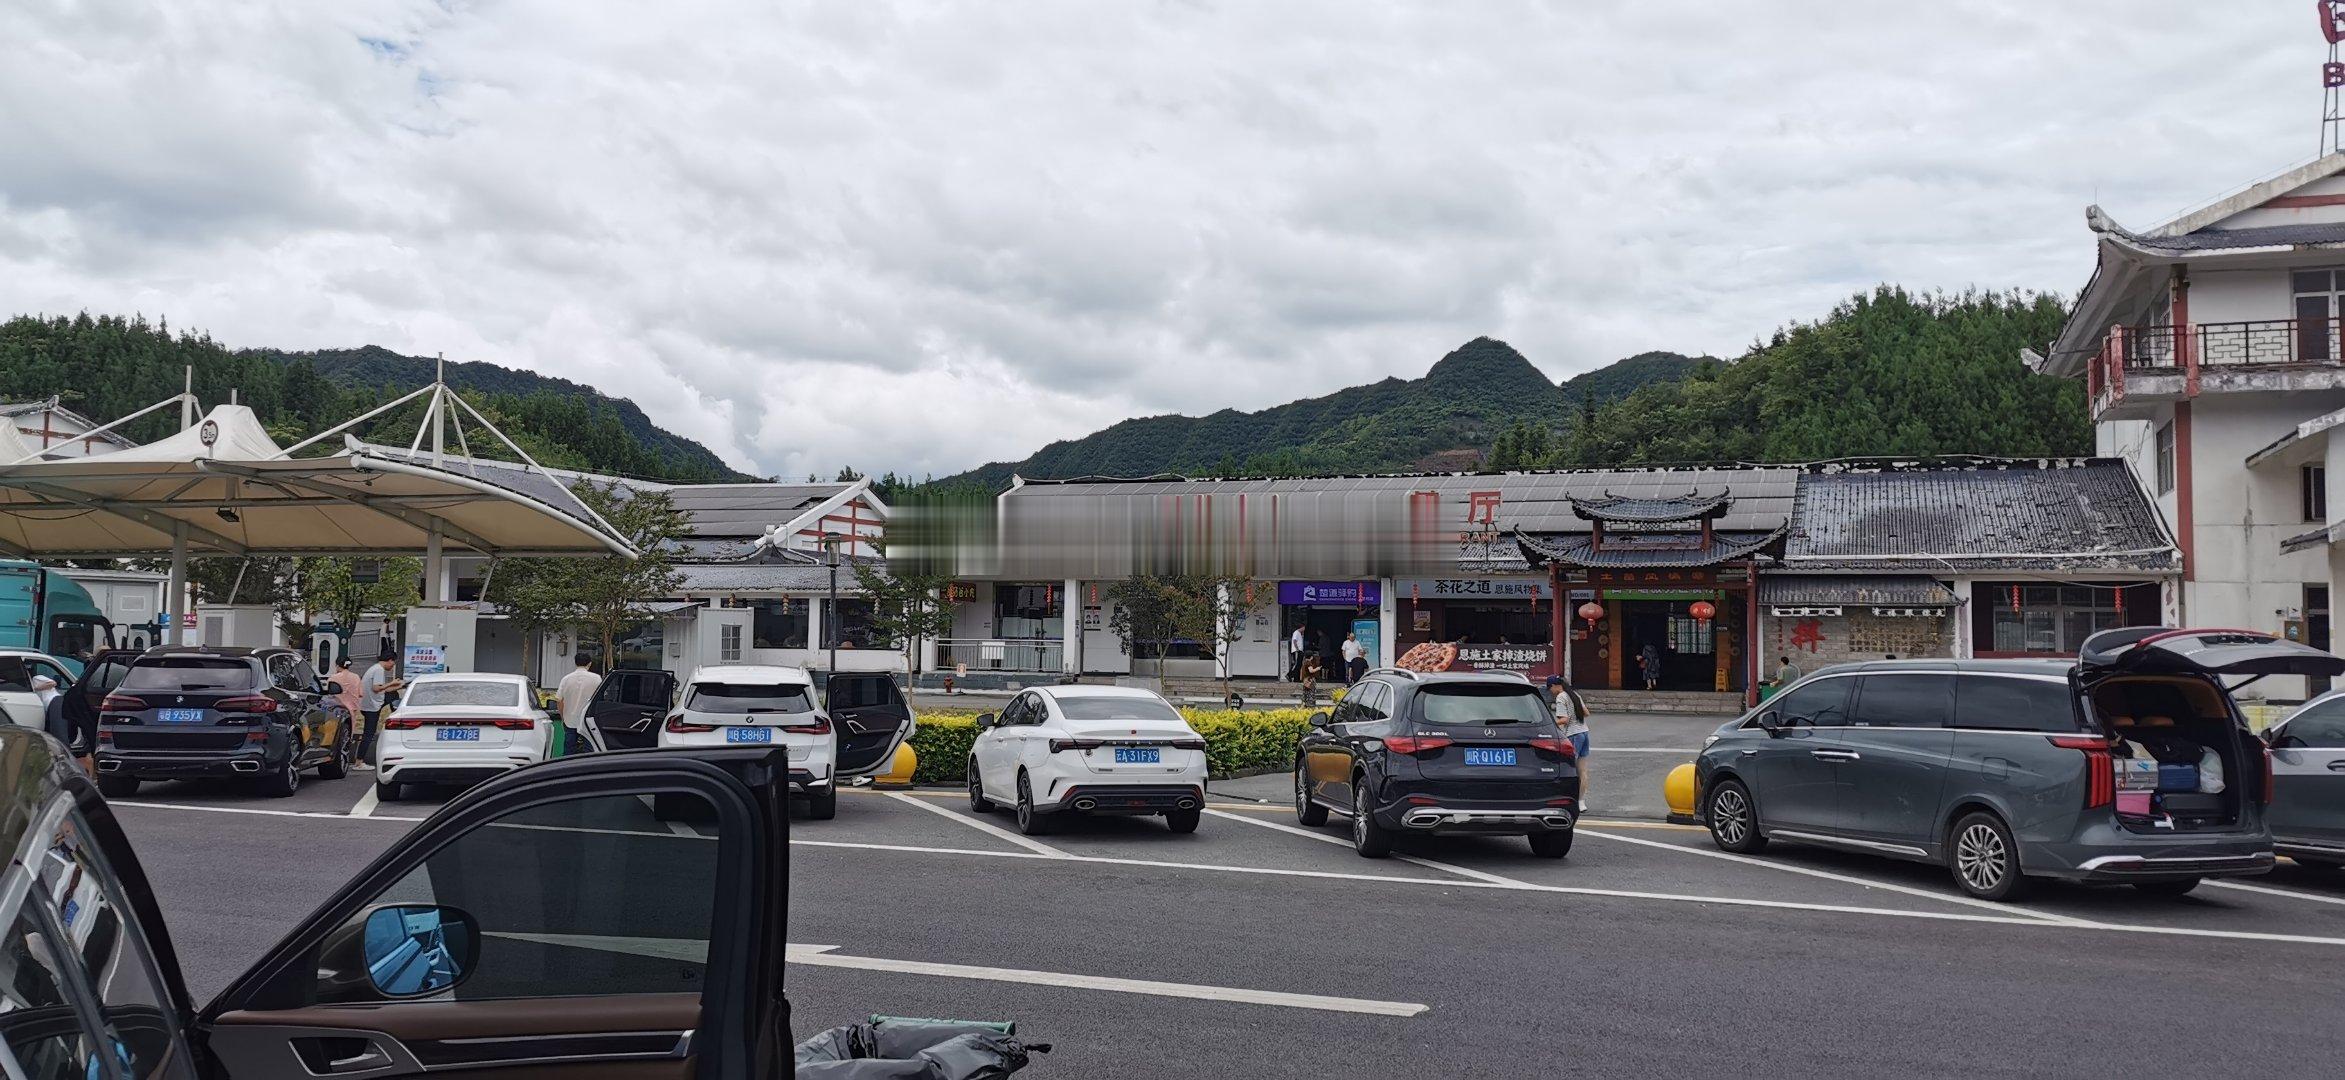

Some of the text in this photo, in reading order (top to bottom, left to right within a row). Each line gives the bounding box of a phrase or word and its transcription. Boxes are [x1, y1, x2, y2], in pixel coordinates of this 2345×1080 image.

[1468, 491, 1501, 525] 厅
[1434, 580, 1492, 595] 茶花之道
[1459, 648, 1548, 662] 恩施土家掉渣烧饼
